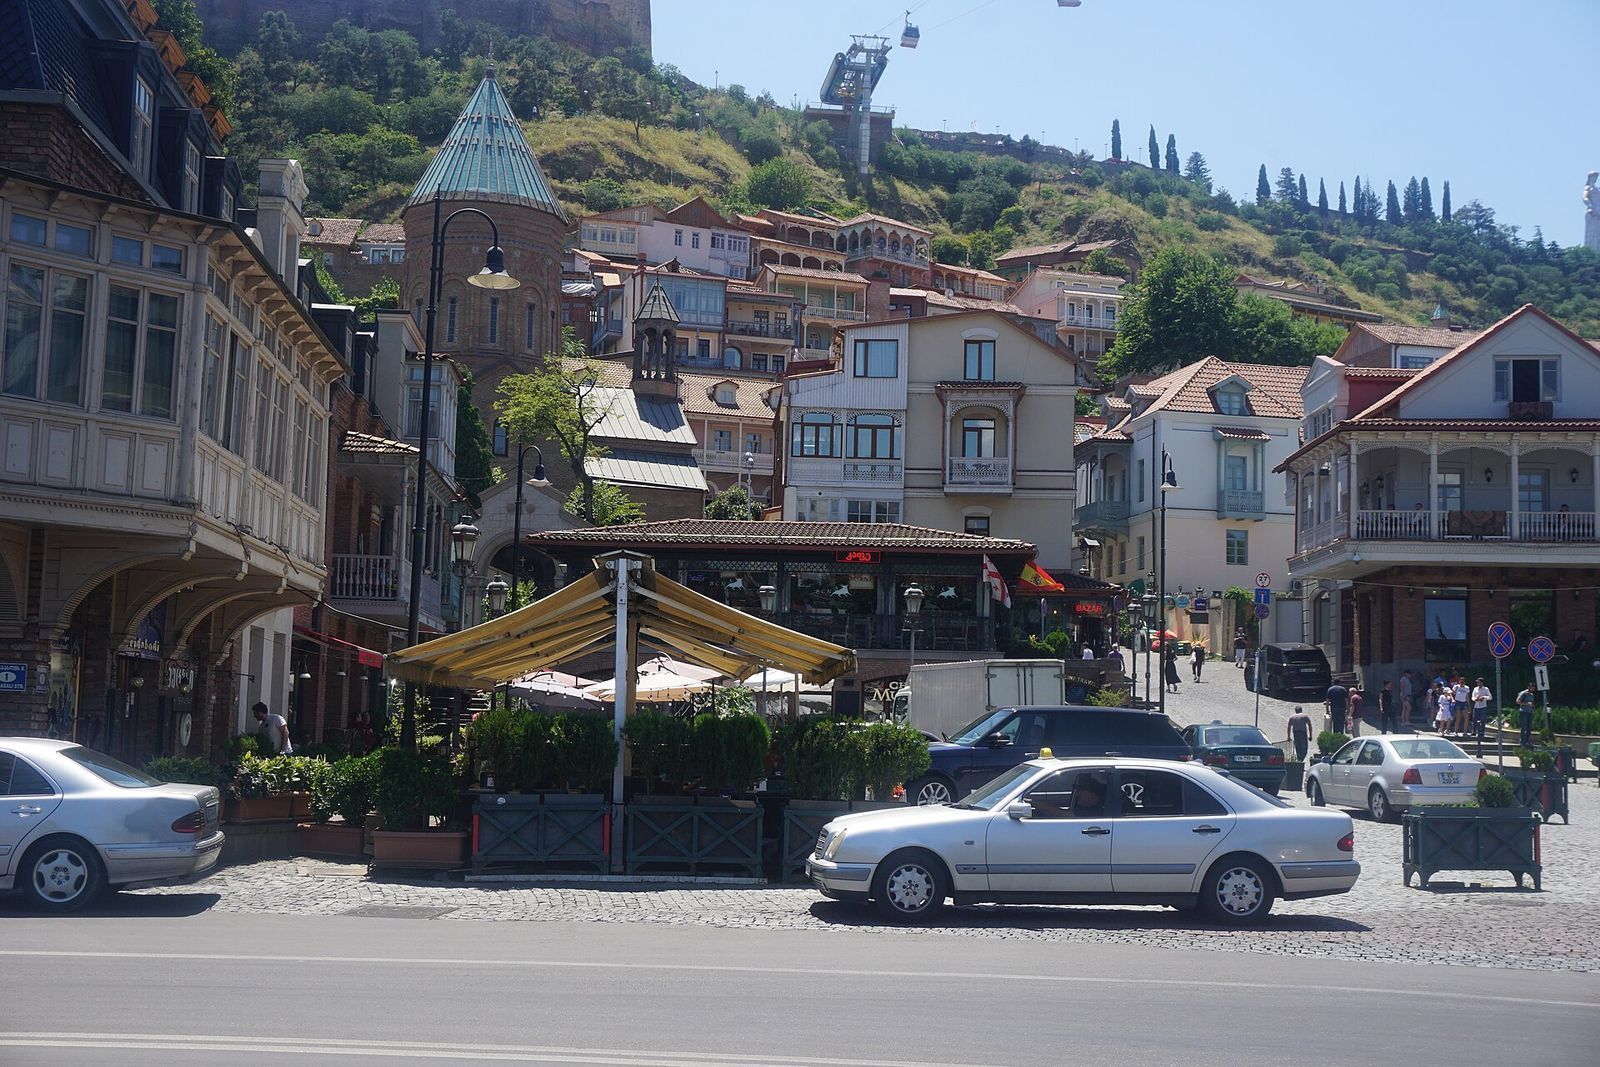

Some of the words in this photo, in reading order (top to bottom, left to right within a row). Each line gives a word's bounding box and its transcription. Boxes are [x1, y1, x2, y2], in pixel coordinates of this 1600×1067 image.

[1075, 604, 1102, 613] BAZAR
[128, 637, 160, 652] eidabadi
[889, 681, 907, 690] CH
[871, 687, 896, 702] MU
